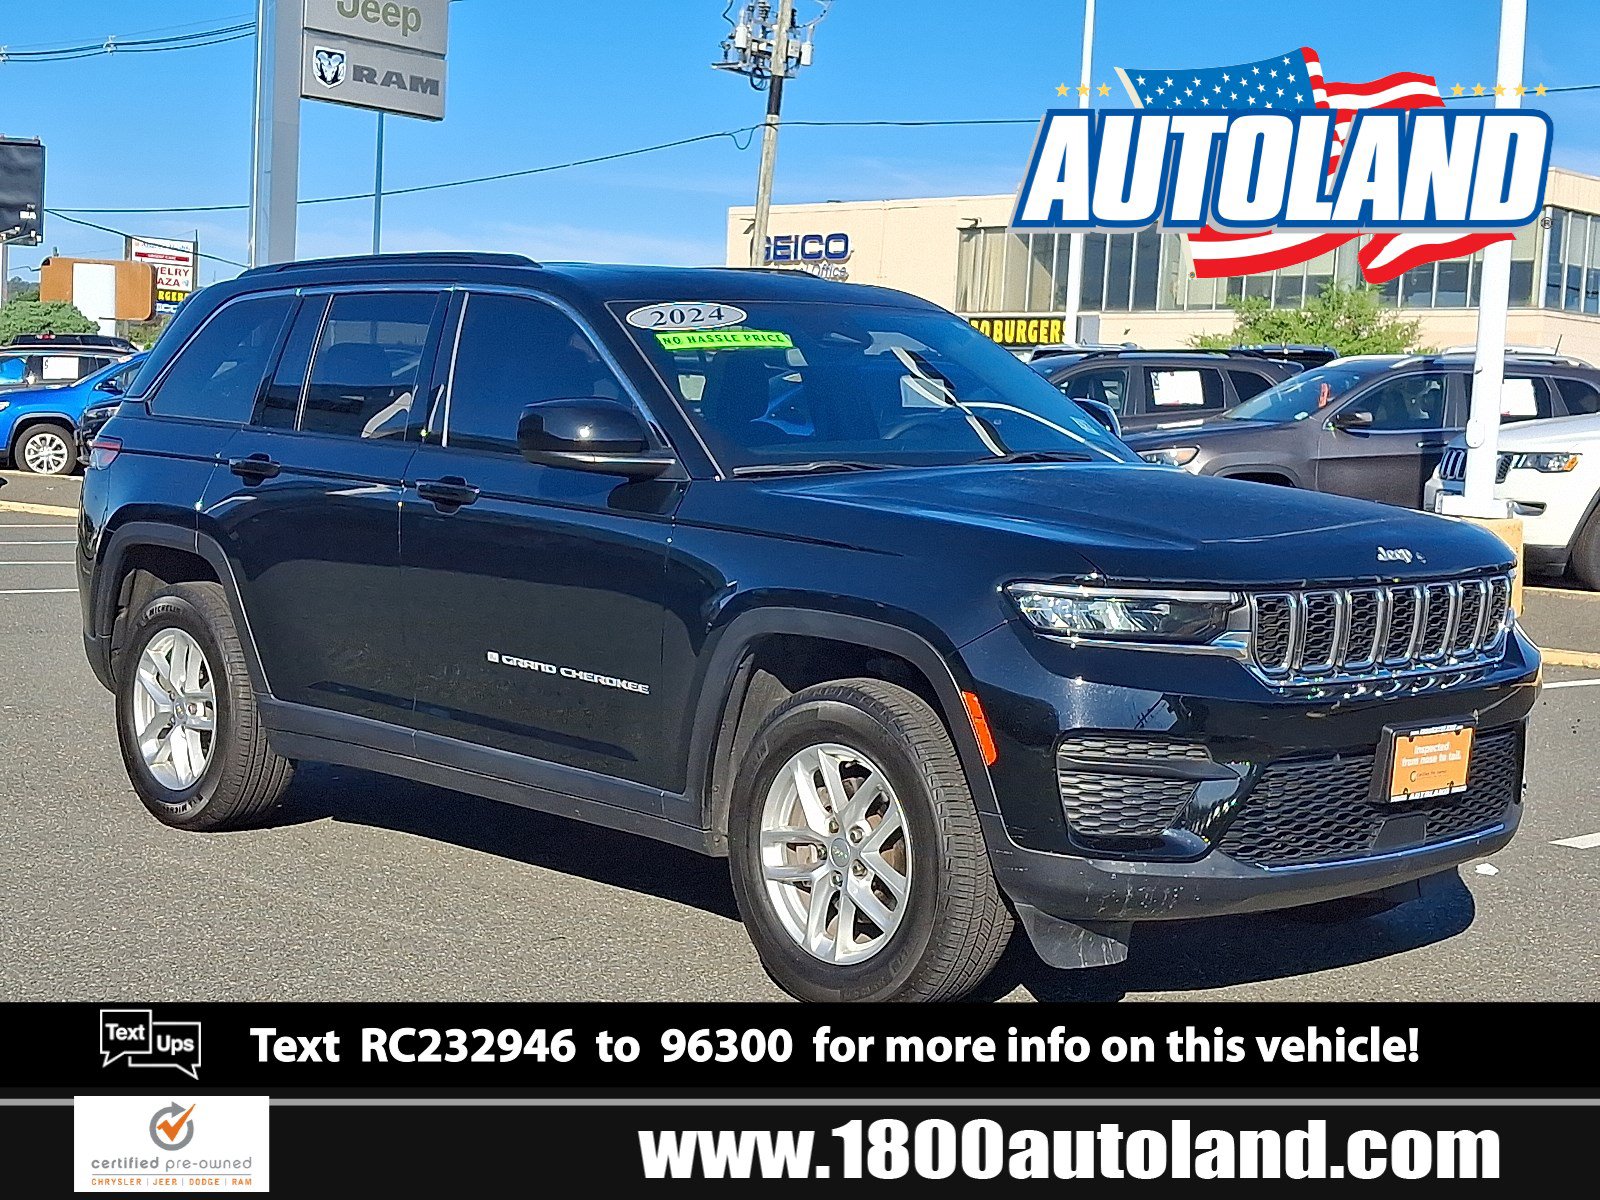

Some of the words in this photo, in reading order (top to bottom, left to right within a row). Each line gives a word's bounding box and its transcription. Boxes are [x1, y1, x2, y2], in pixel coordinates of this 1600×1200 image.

[336, 0, 422, 37] Jeep
[352, 64, 440, 96] RAM
[650, 307, 725, 327] 2024
[661, 337, 681, 345] NO
[687, 334, 738, 344] HASSLE
[743, 333, 786, 343] PRICE
[501, 655, 557, 675] GRAND
[559, 667, 650, 695] CHEROKEE
